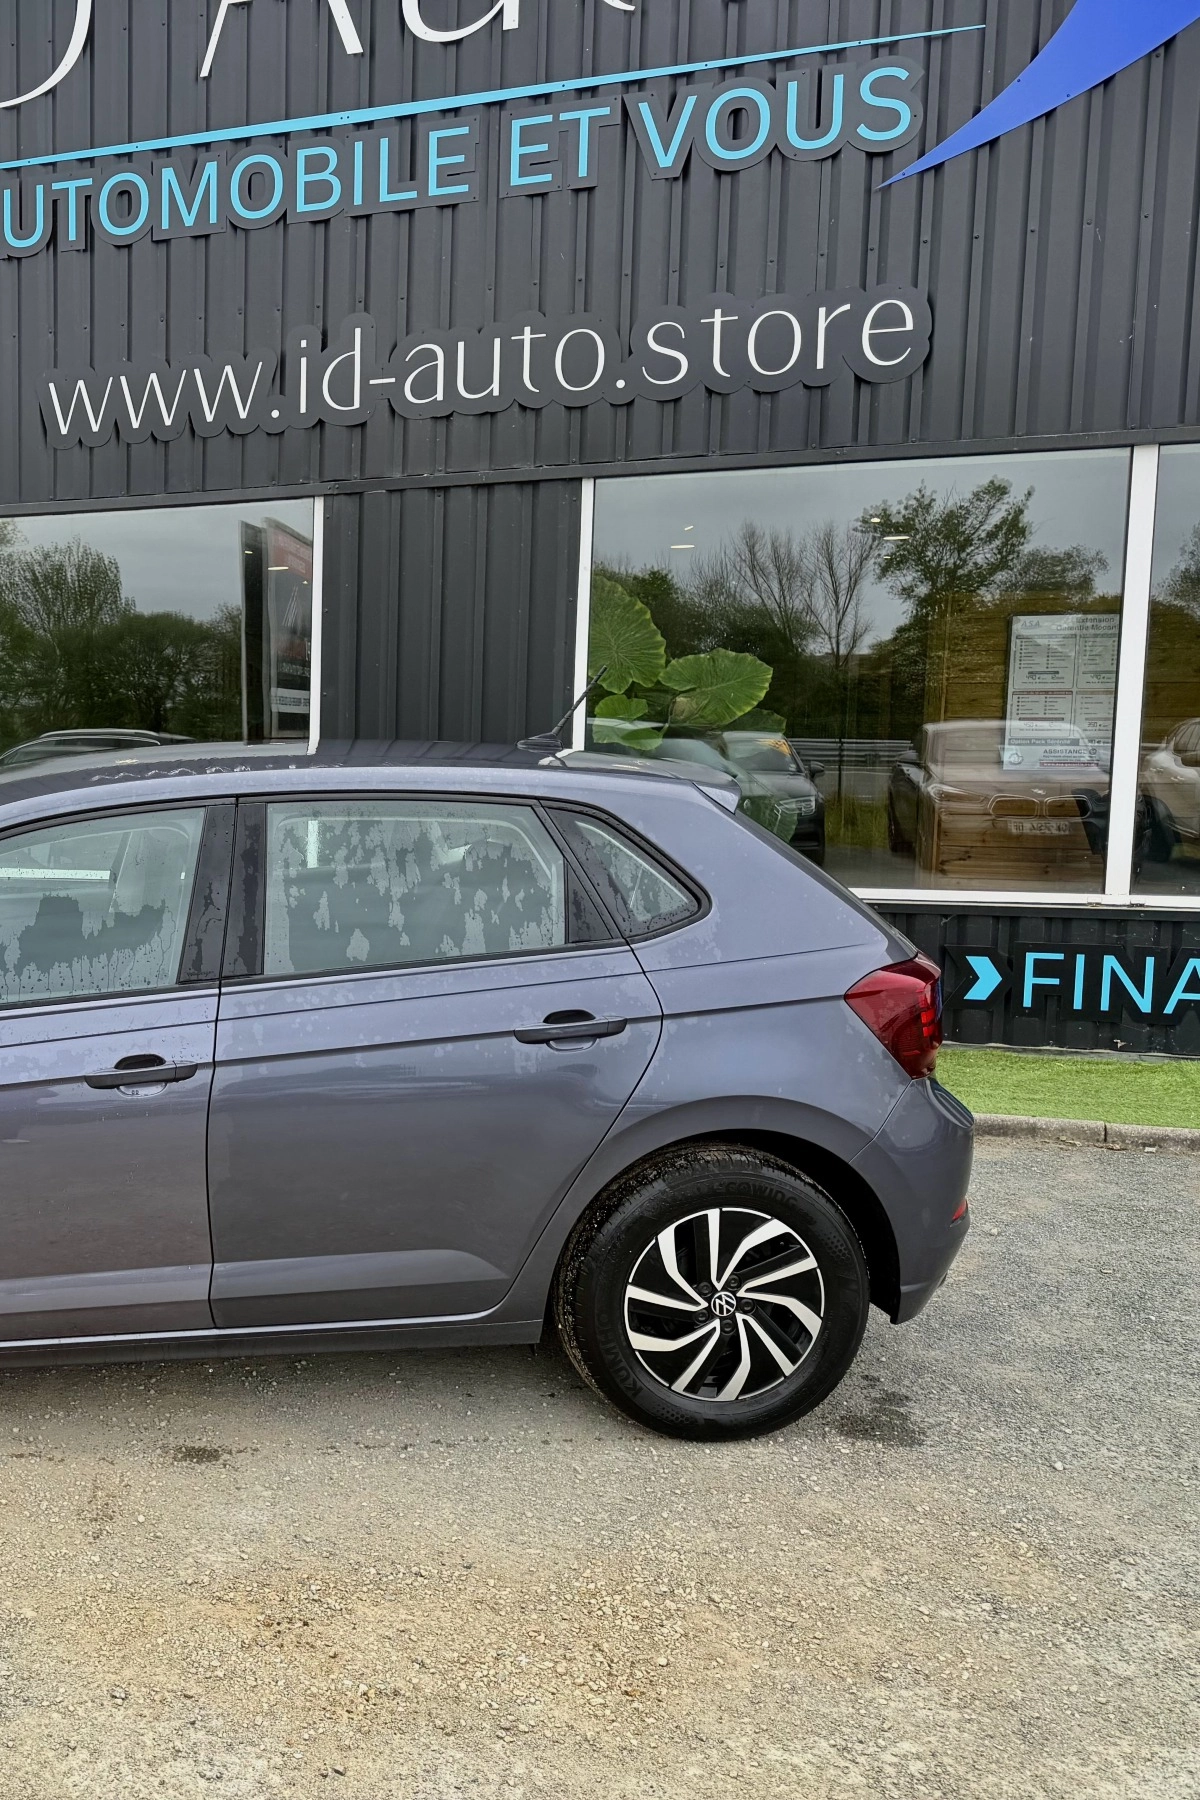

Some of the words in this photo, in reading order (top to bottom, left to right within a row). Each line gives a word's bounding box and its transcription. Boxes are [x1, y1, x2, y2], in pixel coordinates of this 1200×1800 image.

[509, 106, 612, 187] ET
[638, 66, 912, 169] VOUS
[48, 299, 916, 436] www.id-auto.store
